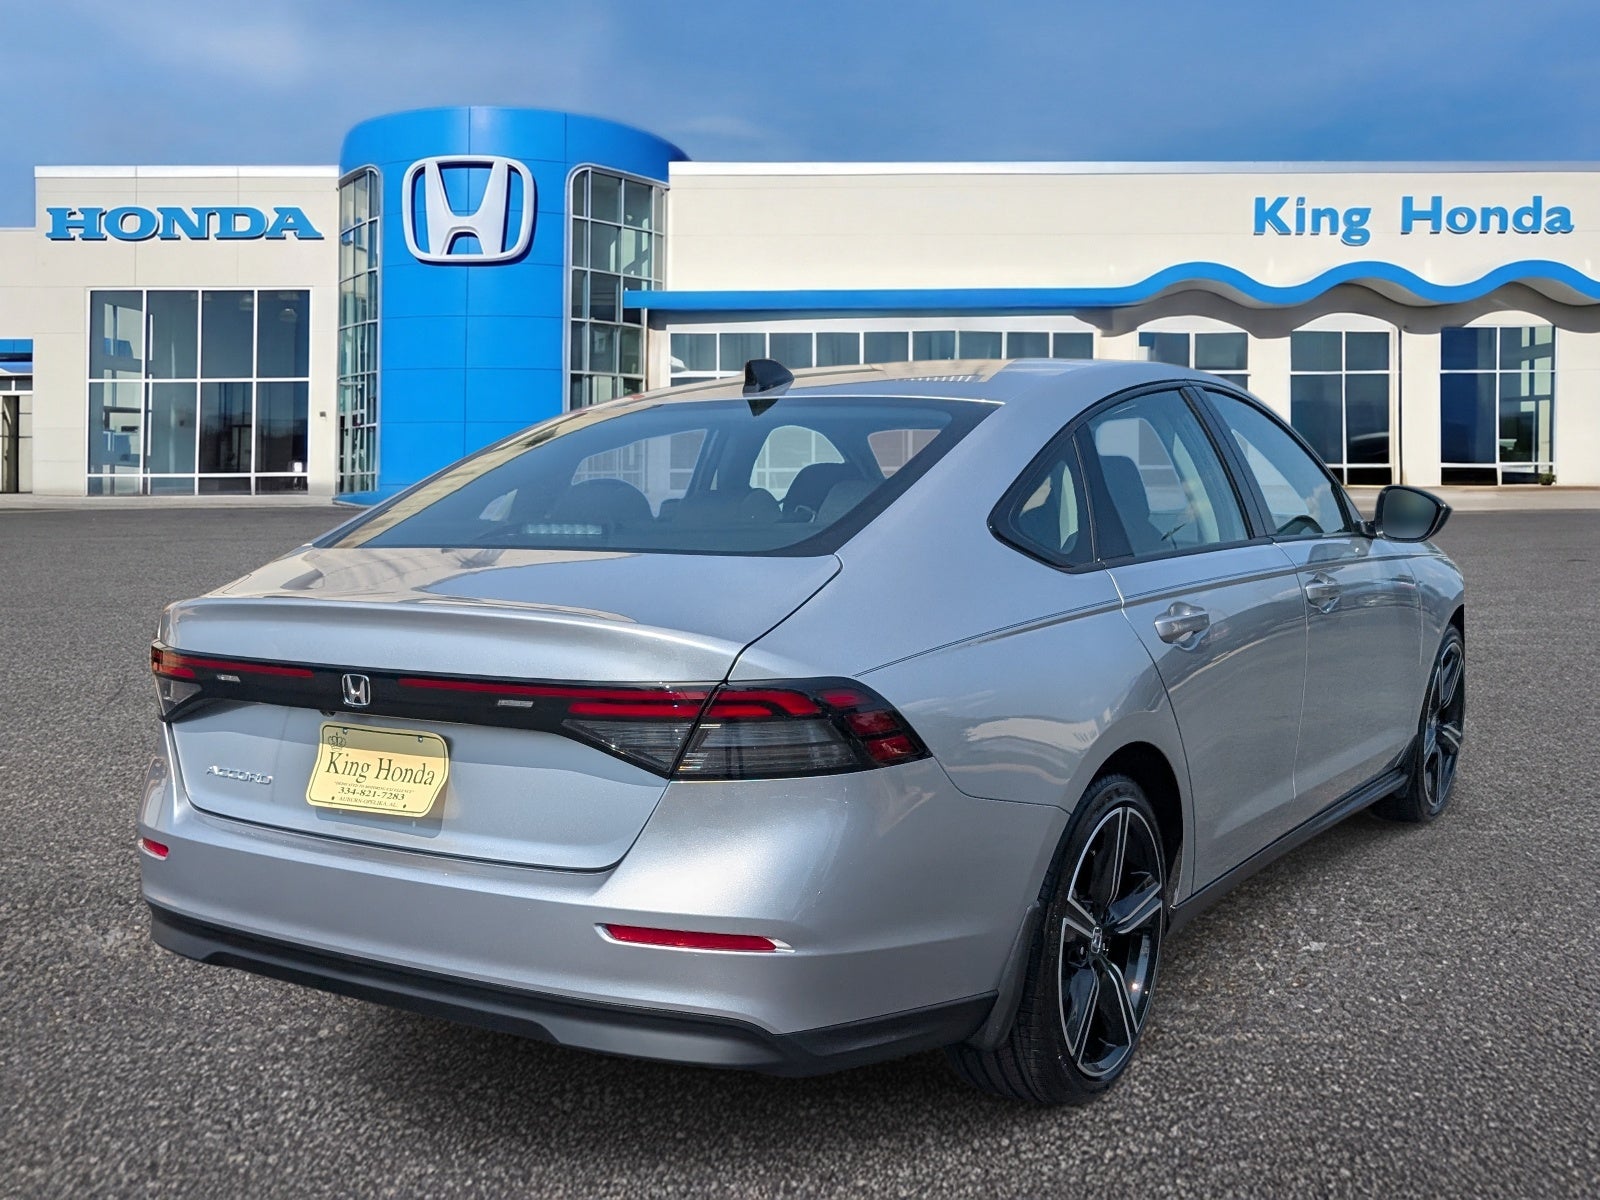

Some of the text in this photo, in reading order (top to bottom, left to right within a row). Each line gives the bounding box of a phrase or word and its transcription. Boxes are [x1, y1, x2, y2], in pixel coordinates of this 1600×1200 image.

[45, 206, 325, 241] HONDA
[1253, 195, 1575, 246] King Honda
[325, 752, 435, 785] King Honda
[338, 786, 405, 800] 334-821-7283
